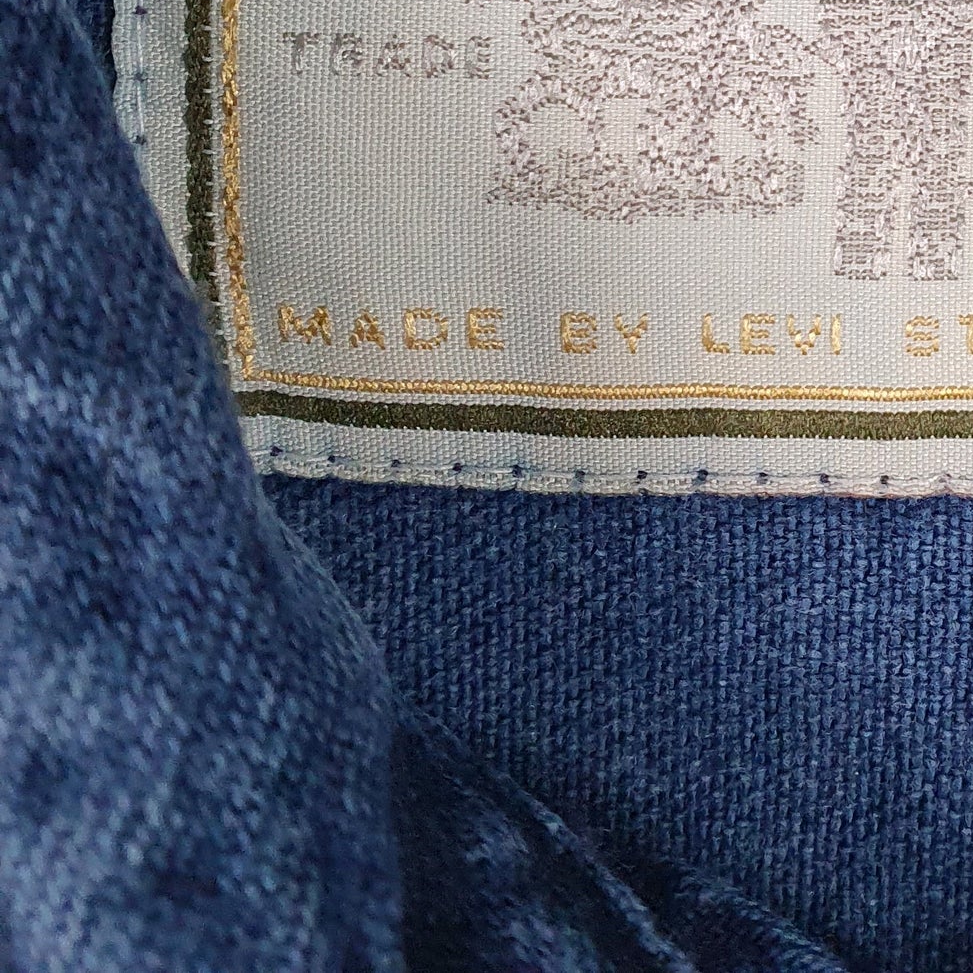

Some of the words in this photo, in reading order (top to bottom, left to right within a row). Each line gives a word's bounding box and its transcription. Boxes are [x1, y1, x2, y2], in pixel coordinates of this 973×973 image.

[281, 32, 493, 79] TRADE
[276, 303, 504, 350] MADE
[559, 311, 649, 354] BY
[702, 311, 843, 355] LEVI
